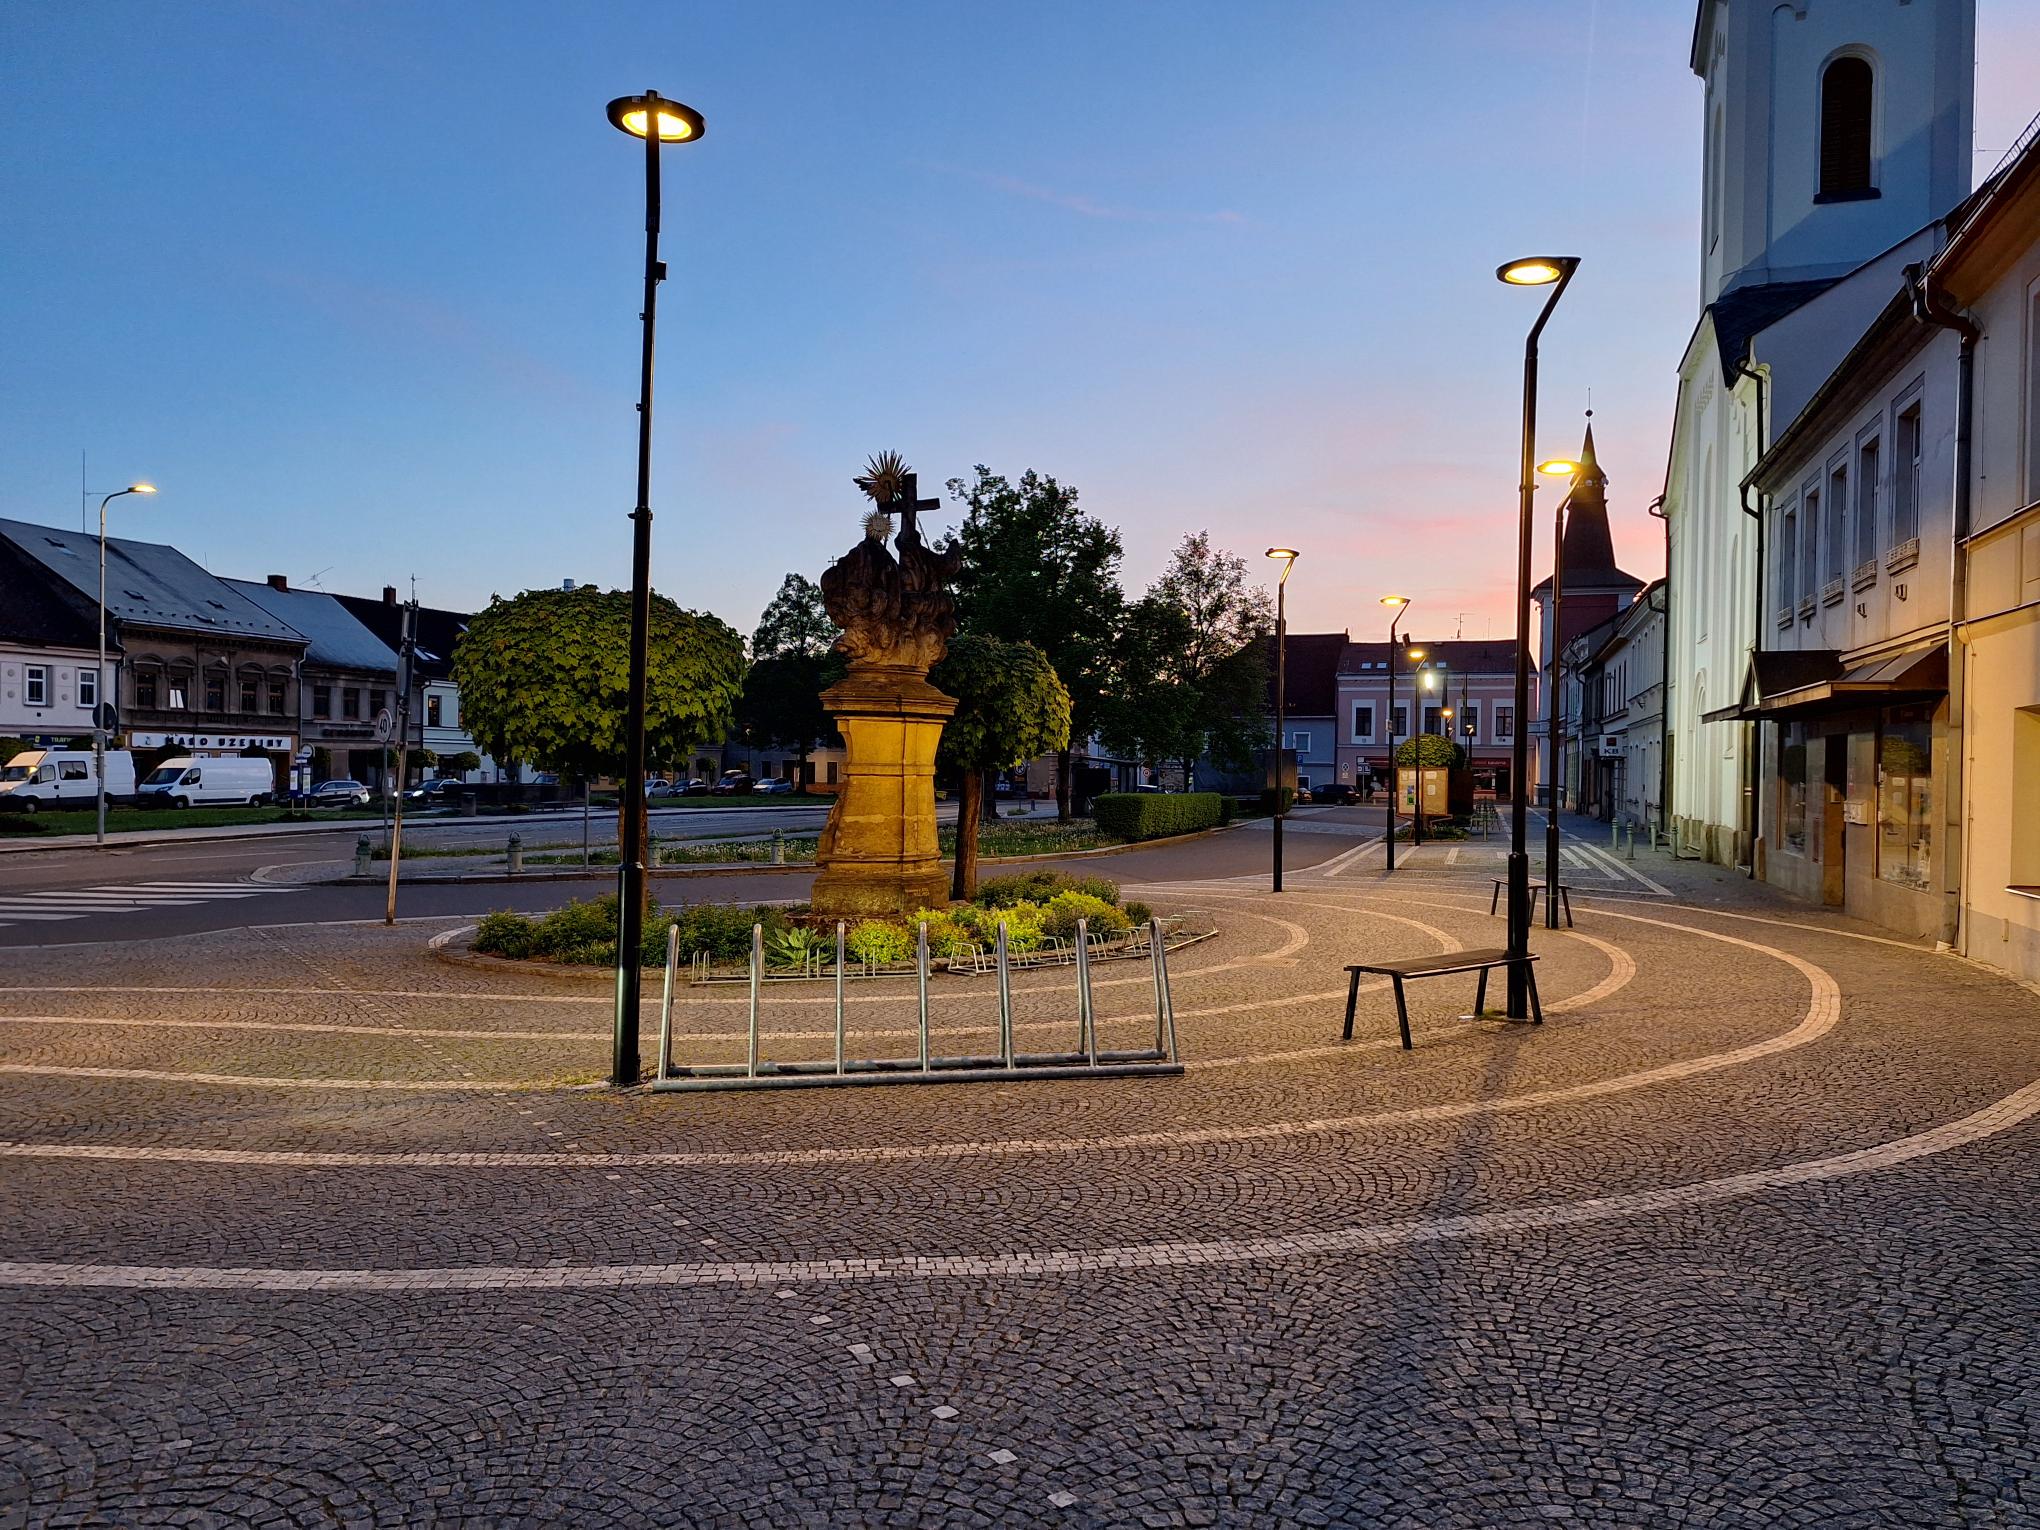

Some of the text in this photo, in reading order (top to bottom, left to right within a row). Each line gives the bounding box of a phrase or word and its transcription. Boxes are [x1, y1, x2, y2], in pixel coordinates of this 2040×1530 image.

[380, 718, 388, 733] 40
[165, 736, 283, 747] MASO UZENINY
